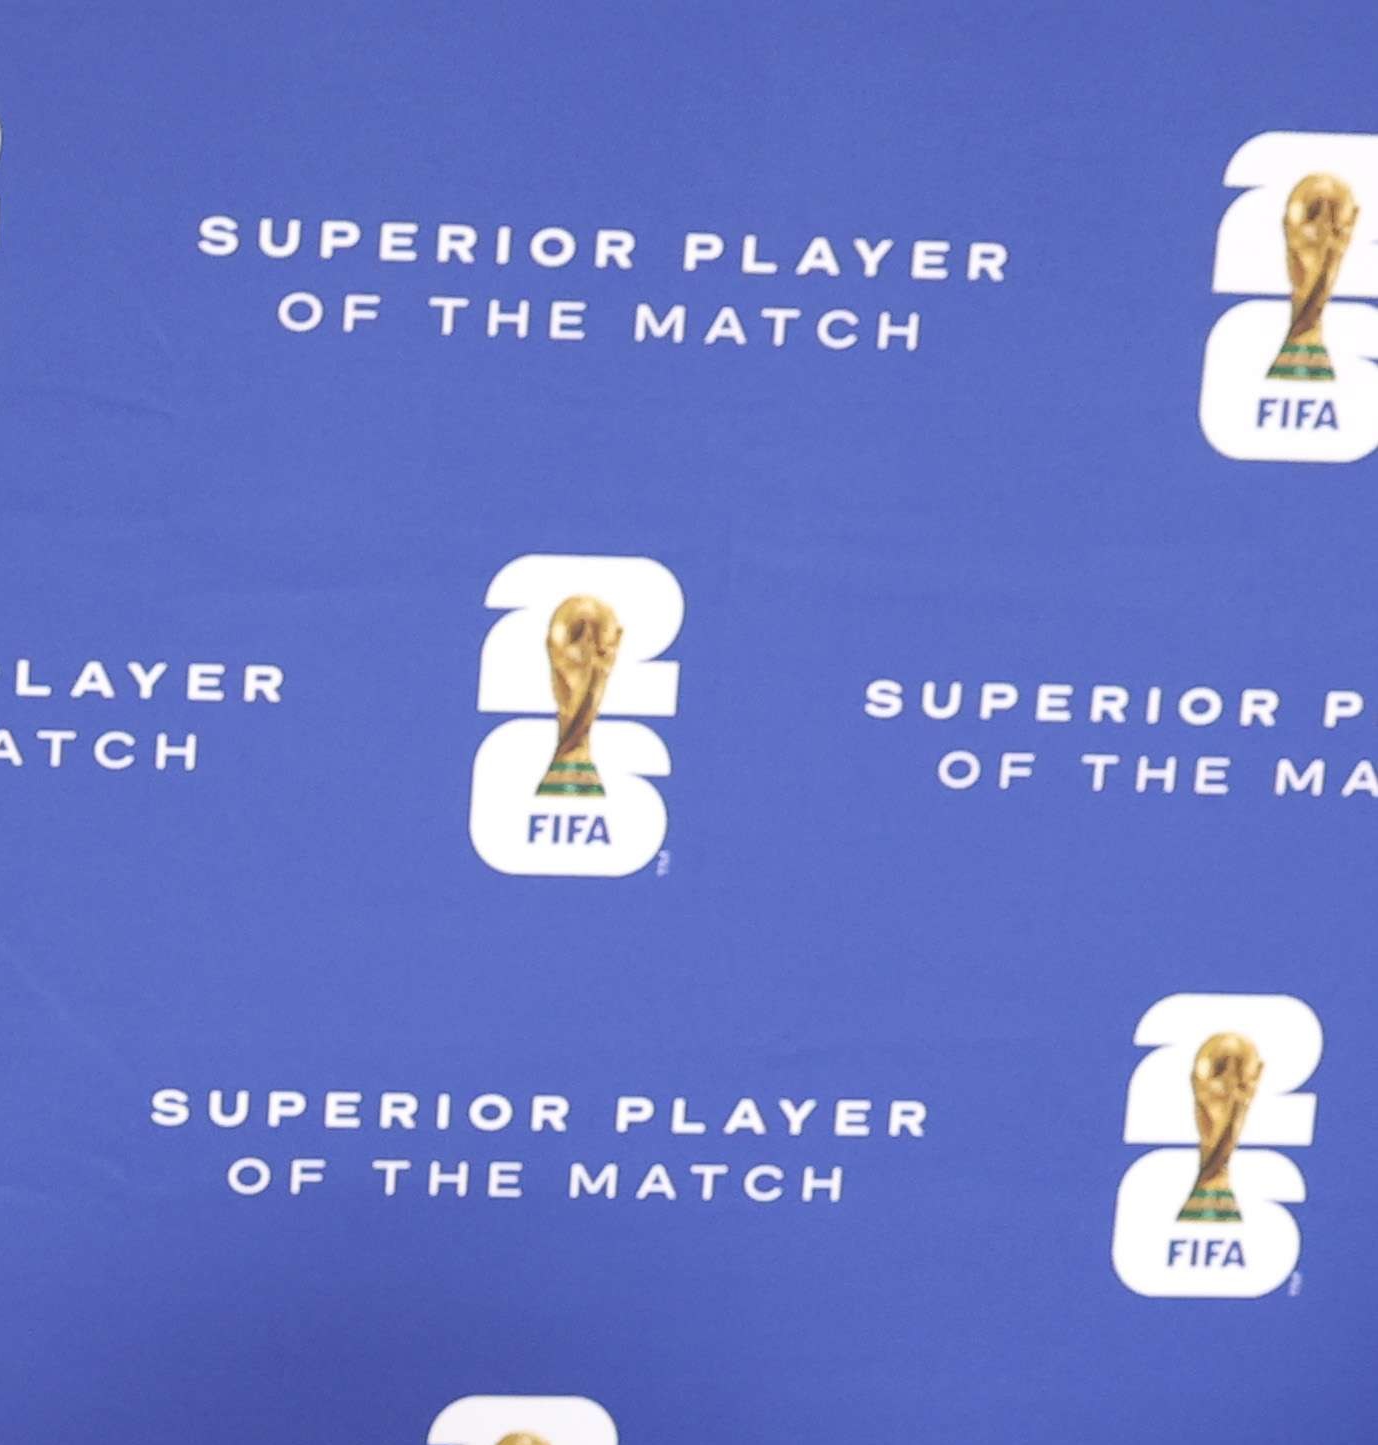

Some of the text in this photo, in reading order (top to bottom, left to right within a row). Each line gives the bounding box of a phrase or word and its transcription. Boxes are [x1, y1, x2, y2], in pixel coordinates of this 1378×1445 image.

[198, 216, 1007, 282] SUPERIOR PLAYER
[278, 292, 919, 351] OF THE MATCH
[1256, 400, 1338, 430] FIFA
[865, 680, 1279, 727] SUPERIOR
[938, 750, 1035, 789] OF
[1081, 754, 1230, 794] THE
[528, 816, 610, 844] FIFA
[151, 1089, 926, 1137] SUPERIOR PLAYER
[228, 1158, 842, 1202] OF THE MATCH
[1167, 1240, 1246, 1266] FIFA
